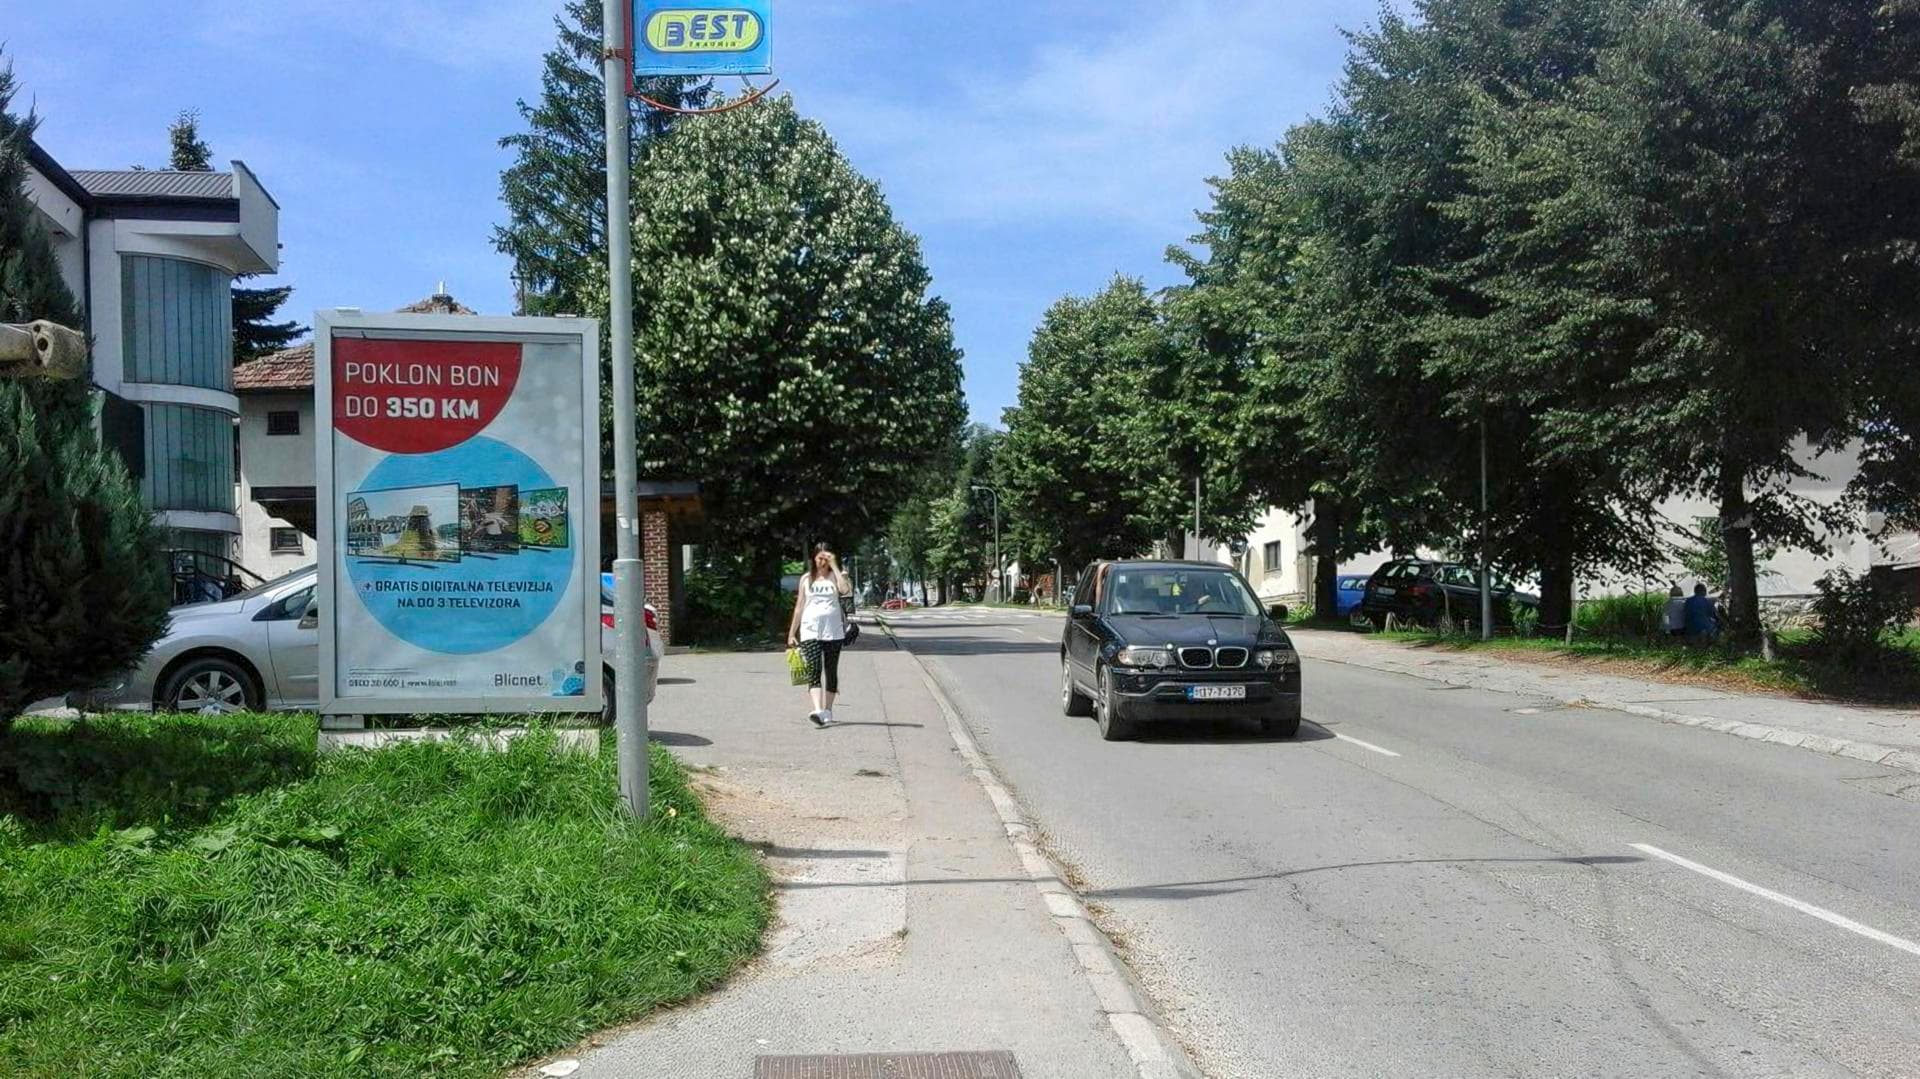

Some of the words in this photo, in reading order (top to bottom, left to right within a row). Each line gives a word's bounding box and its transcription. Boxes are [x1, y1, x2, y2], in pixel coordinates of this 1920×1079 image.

[659, 14, 749, 47] BEST
[345, 362, 441, 385] POKLON
[450, 365, 499, 387] BON
[345, 396, 378, 417] DO
[386, 397, 435, 418] 350
[441, 398, 479, 419] KM
[375, 580, 418, 592] GRATIS
[421, 580, 484, 592] DIGITALNA
[488, 581, 554, 593] TELEVIZIJA
[397, 598, 415, 608] NA
[417, 598, 434, 608] DO
[437, 598, 445, 608] 3
[449, 598, 521, 608] TELEVIZORA
[494, 673, 543, 687] Blicnet
